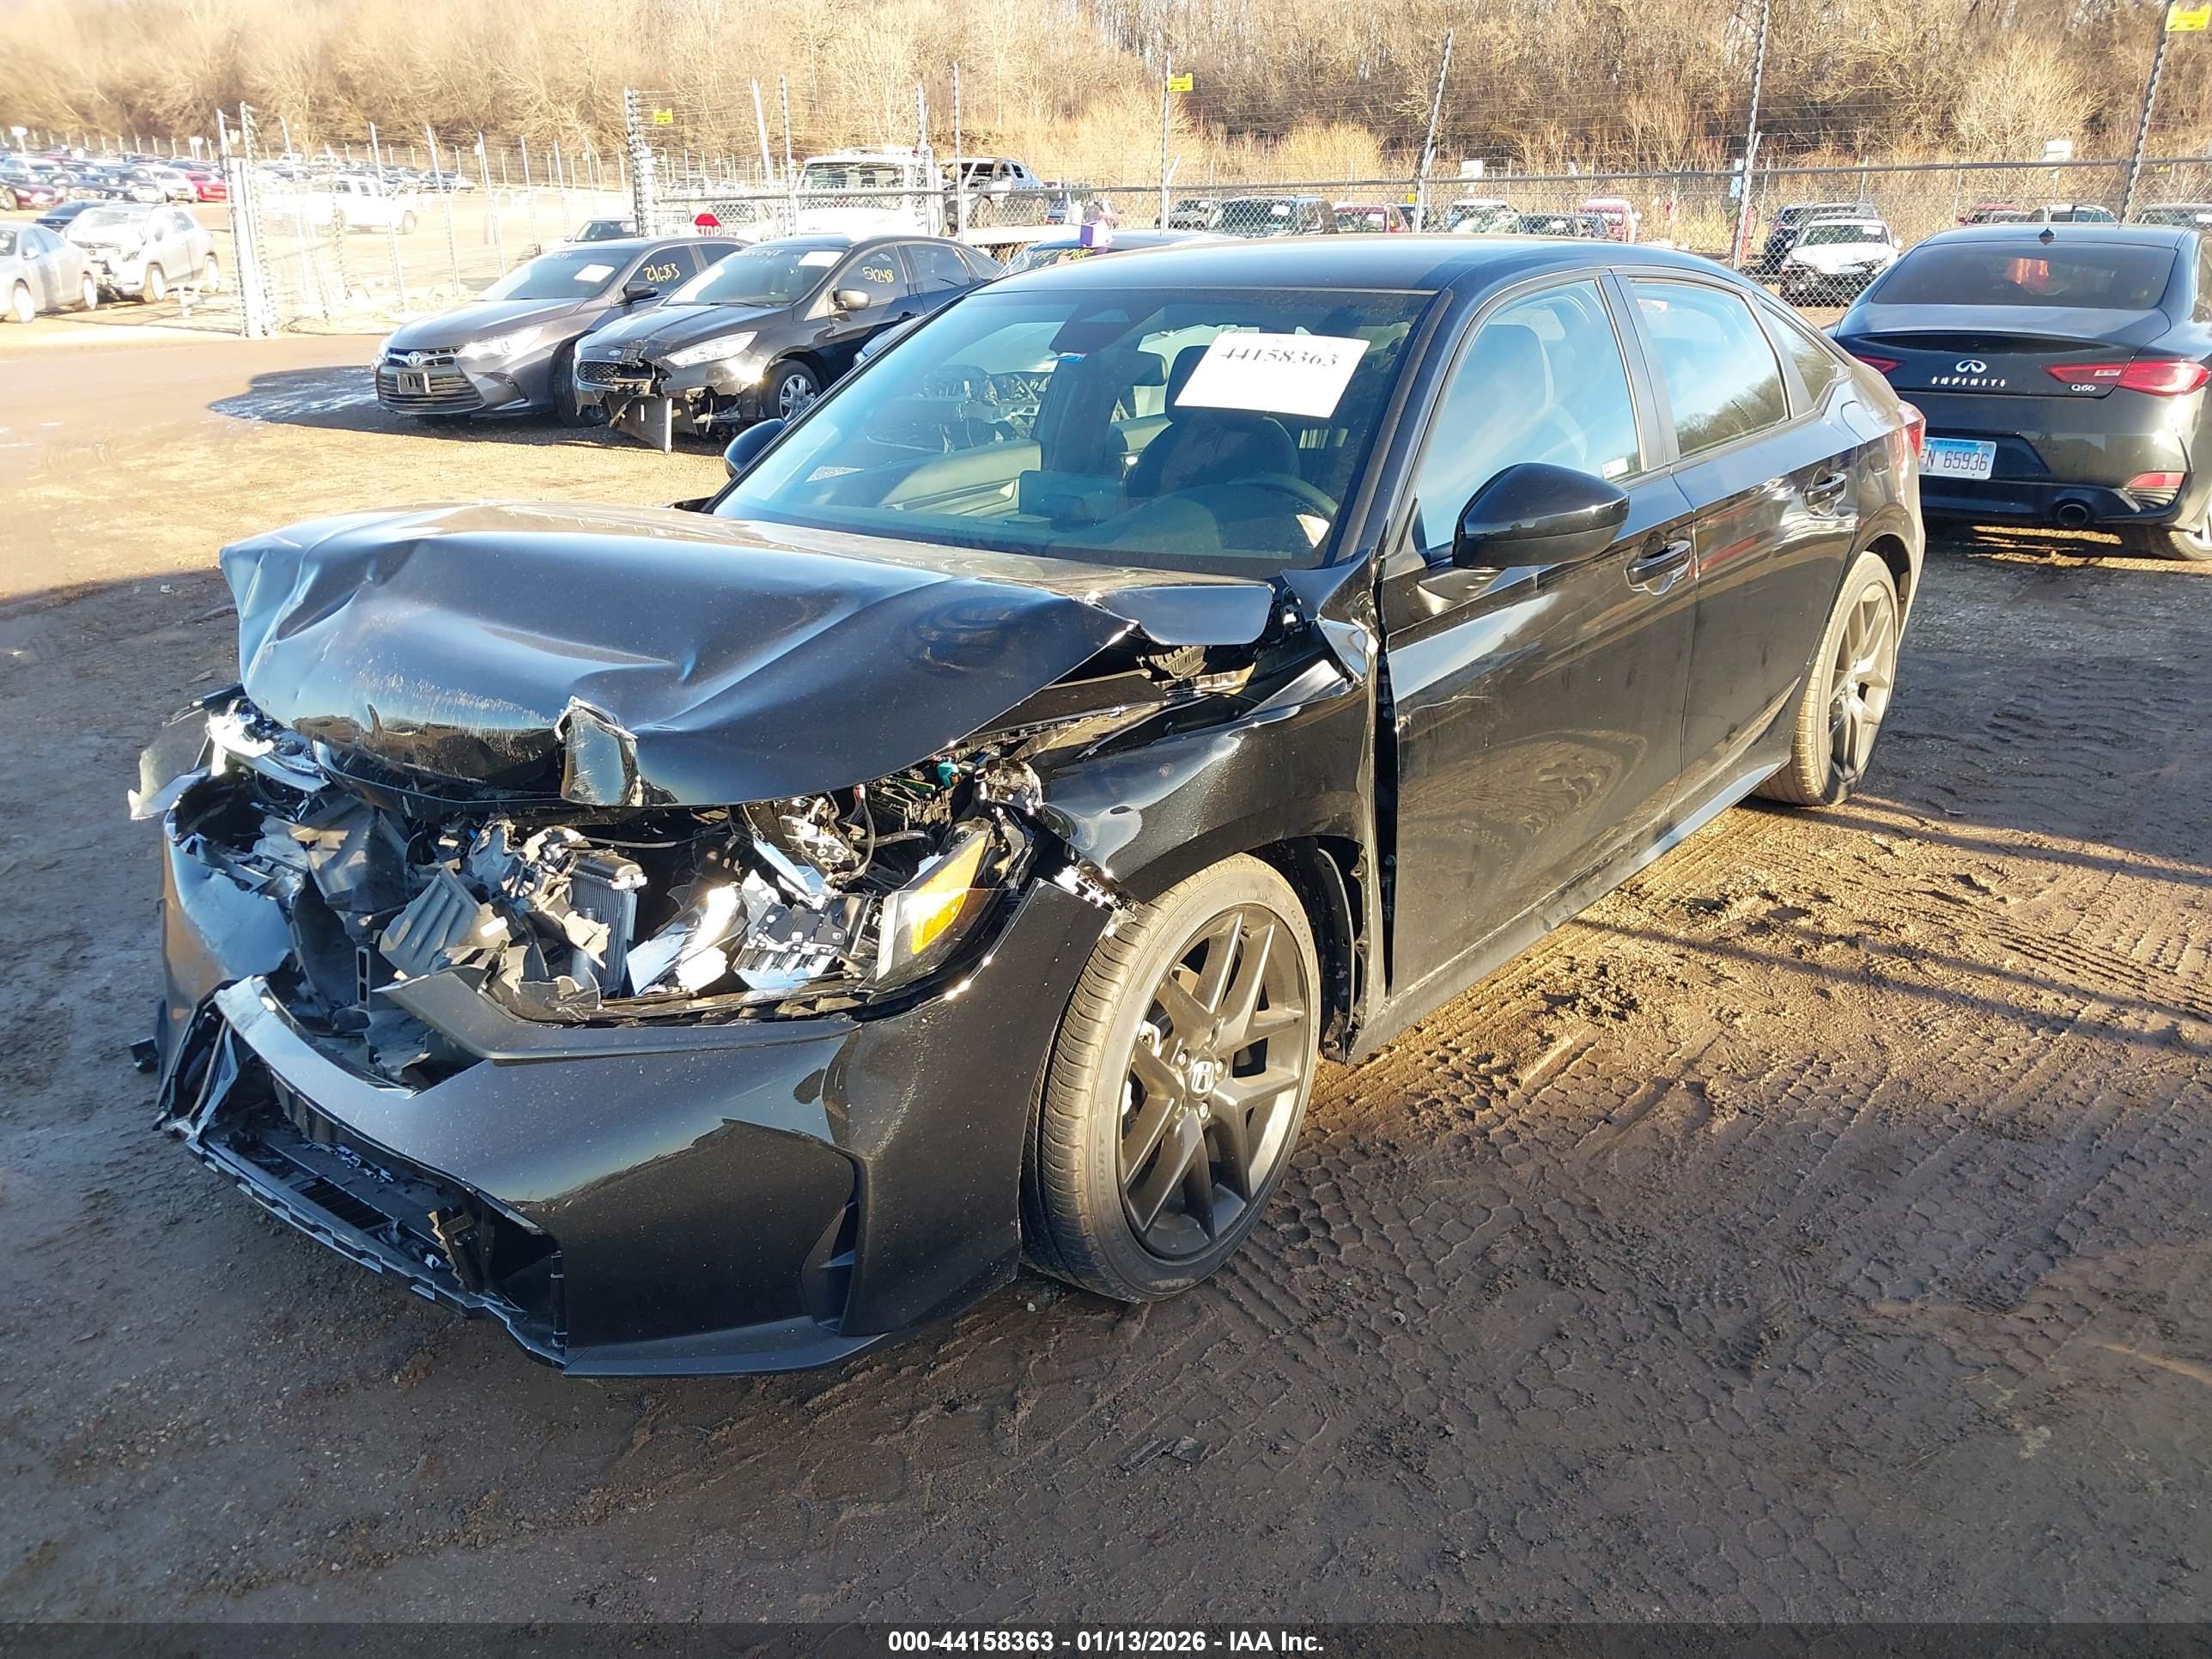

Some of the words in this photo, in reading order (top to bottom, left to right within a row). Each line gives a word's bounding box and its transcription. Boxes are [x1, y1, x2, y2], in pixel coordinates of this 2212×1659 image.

[862, 266, 895, 283] 51248
[1931, 376, 2007, 387] INFINITI
[1943, 450, 1990, 471] 65936
